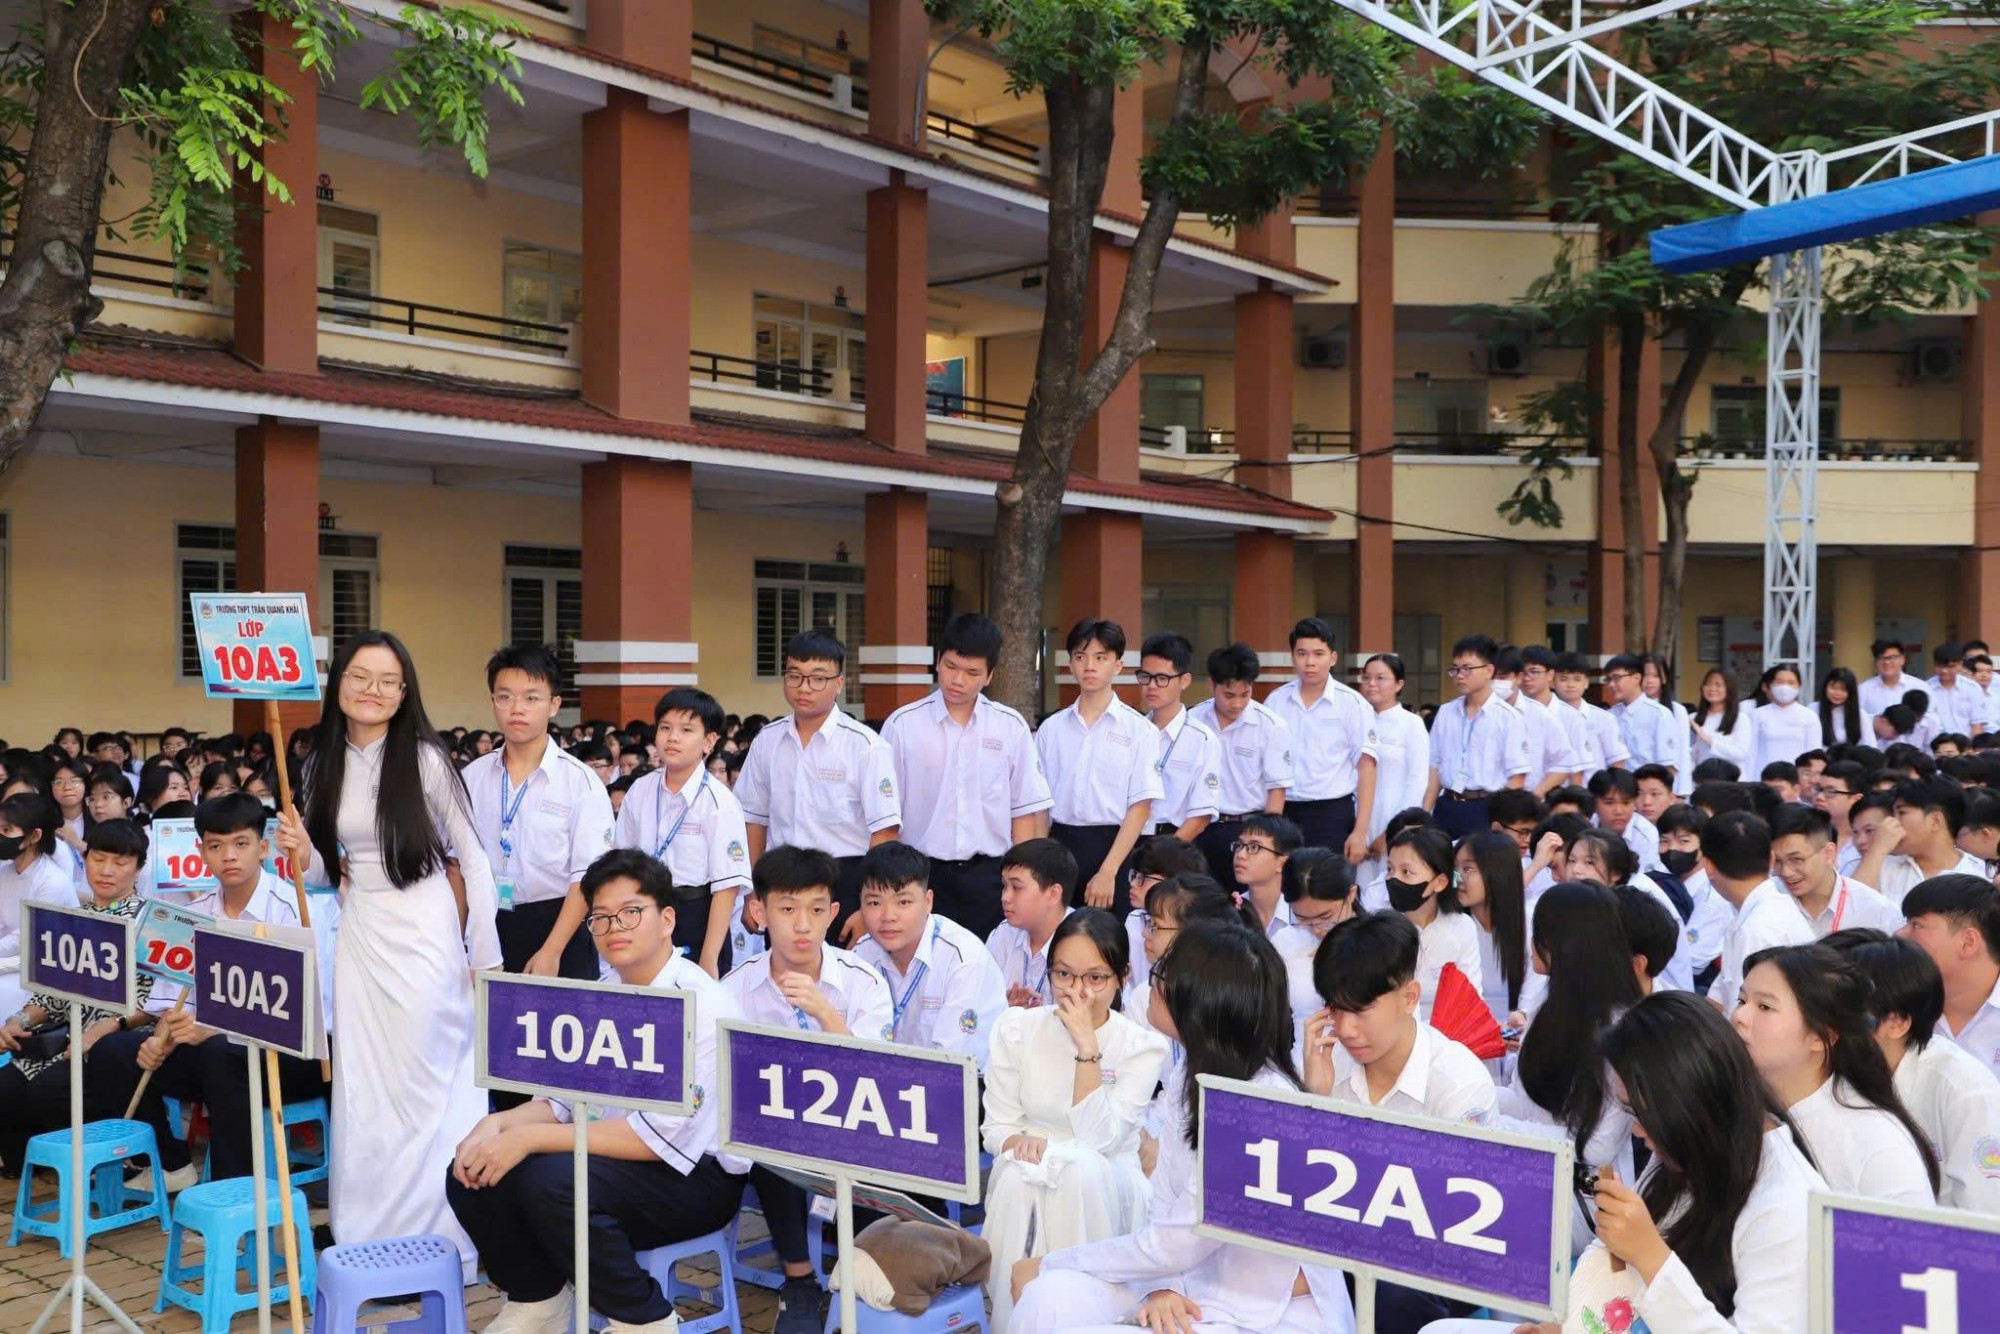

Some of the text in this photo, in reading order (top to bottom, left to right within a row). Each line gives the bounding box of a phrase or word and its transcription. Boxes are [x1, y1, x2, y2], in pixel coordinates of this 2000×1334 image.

[237, 604, 250, 614] THPT
[238, 618, 264, 637] LỚP
[214, 645, 301, 683] 10A3
[167, 854, 214, 879] 10
[40, 929, 120, 982] 10A3
[148, 940, 195, 975] 10
[209, 961, 290, 1021] 10A2
[515, 1010, 665, 1074] 10A1
[758, 1063, 939, 1145] 12A1
[1244, 1137, 1507, 1255] 12A2
